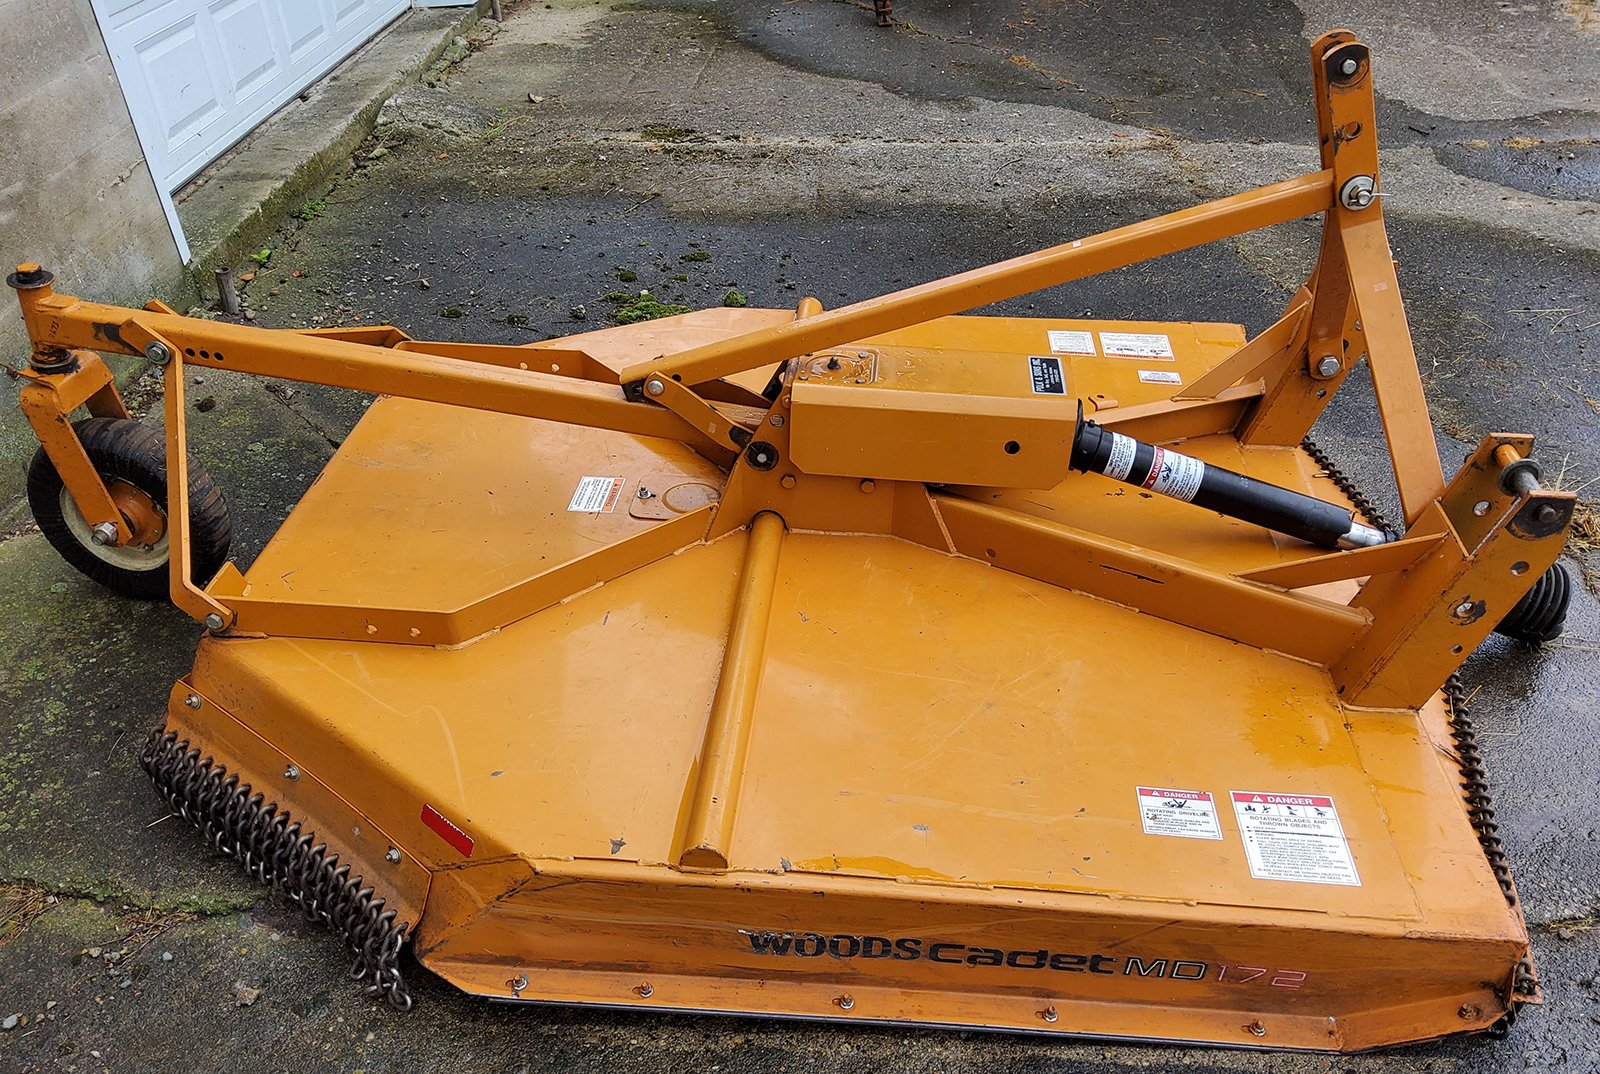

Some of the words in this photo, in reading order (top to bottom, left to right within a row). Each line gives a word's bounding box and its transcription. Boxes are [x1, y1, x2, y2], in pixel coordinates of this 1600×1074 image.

[1033, 366, 1042, 376] SONS
[1110, 440, 1119, 467] IMPORTANT
[1152, 448, 1164, 477] DANGER
[1163, 791, 1198, 800] DANGER
[1266, 796, 1314, 805] DANGER
[738, 929, 922, 961] WOODS
[927, 943, 1120, 974] Cadet
[1123, 956, 1209, 980] MD
[1215, 963, 1311, 991] 172
